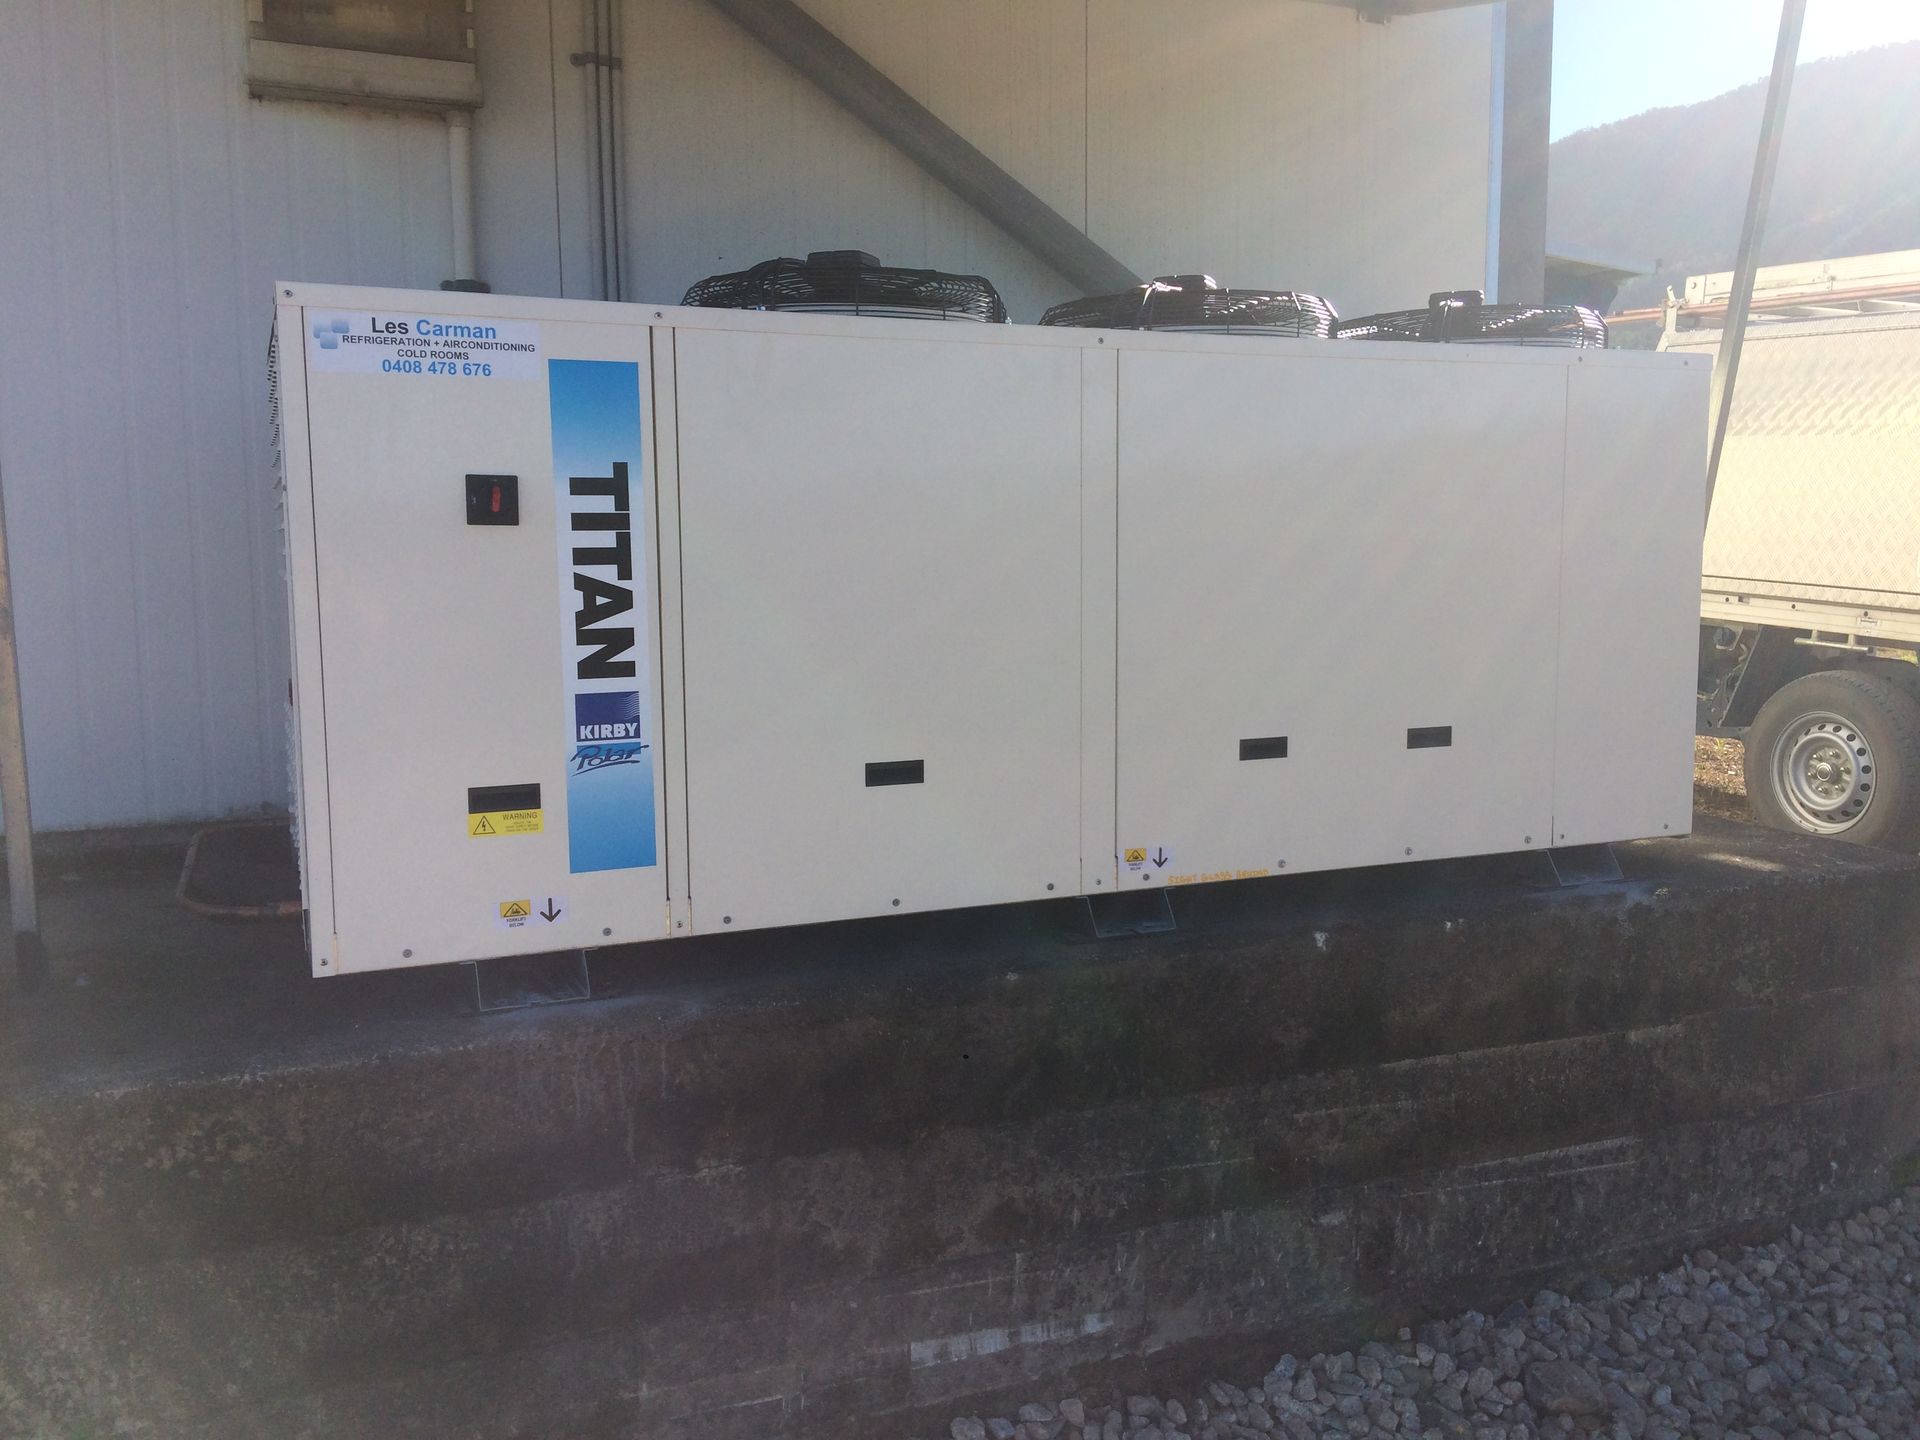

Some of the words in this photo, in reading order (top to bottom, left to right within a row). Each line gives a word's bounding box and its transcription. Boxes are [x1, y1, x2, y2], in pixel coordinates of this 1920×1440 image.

[372, 317, 409, 334] Les
[416, 319, 497, 339] Carman
[342, 335, 431, 347] REFRIGERATION
[443, 339, 536, 352] AIRCONDITIONING
[397, 349, 428, 359] COLD
[430, 351, 470, 360] ROOMS
[382, 359, 422, 374] 0408
[428, 361, 457, 375] 478
[463, 363, 492, 377] 676
[569, 461, 636, 680] TITAN
[580, 723, 638, 739] KIRBY
[570, 744, 650, 771] Polar
[502, 811, 538, 821] WARNING
